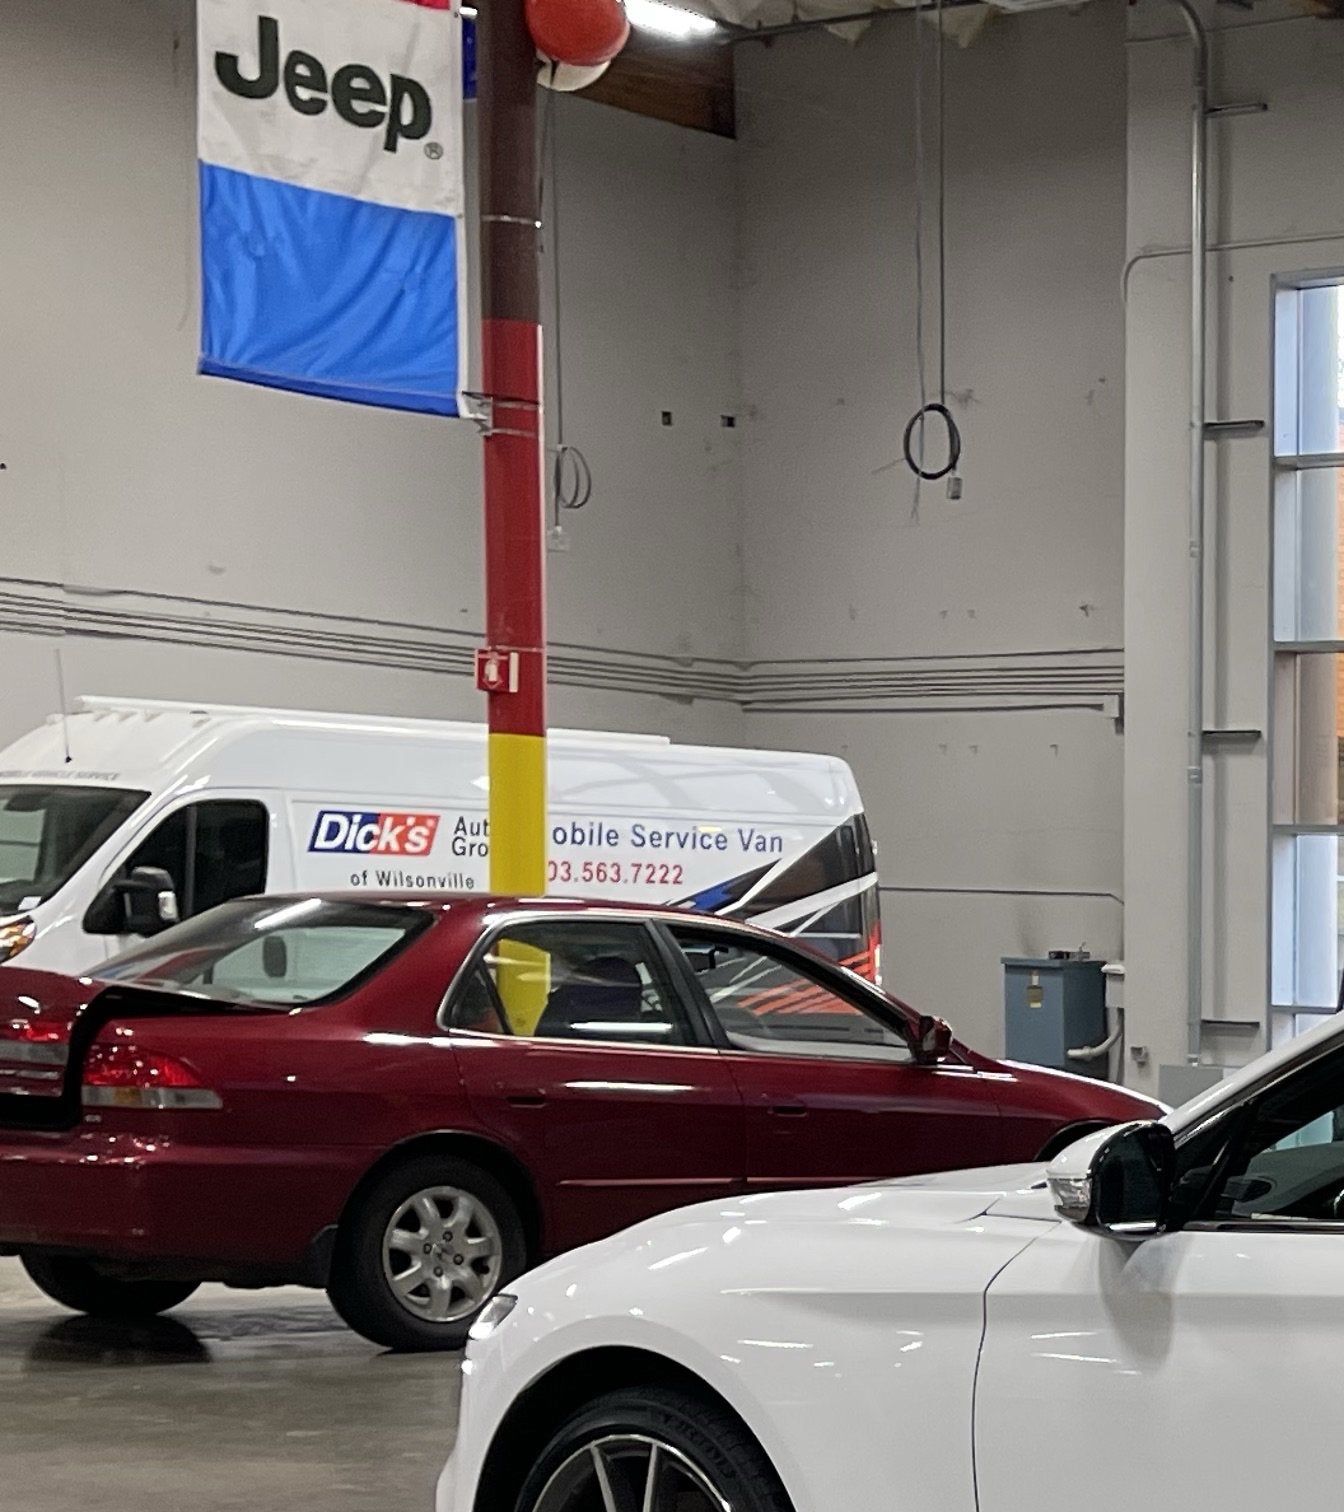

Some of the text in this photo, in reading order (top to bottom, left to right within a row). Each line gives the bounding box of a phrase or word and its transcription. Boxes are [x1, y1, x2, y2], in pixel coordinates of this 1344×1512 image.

[453, 816, 489, 837] Aut
[552, 821, 783, 853] obile Service Van
[452, 836, 489, 857] Gro
[351, 871, 475, 889] of Wilsonville
[548, 860, 683, 885] 03.563.7222
